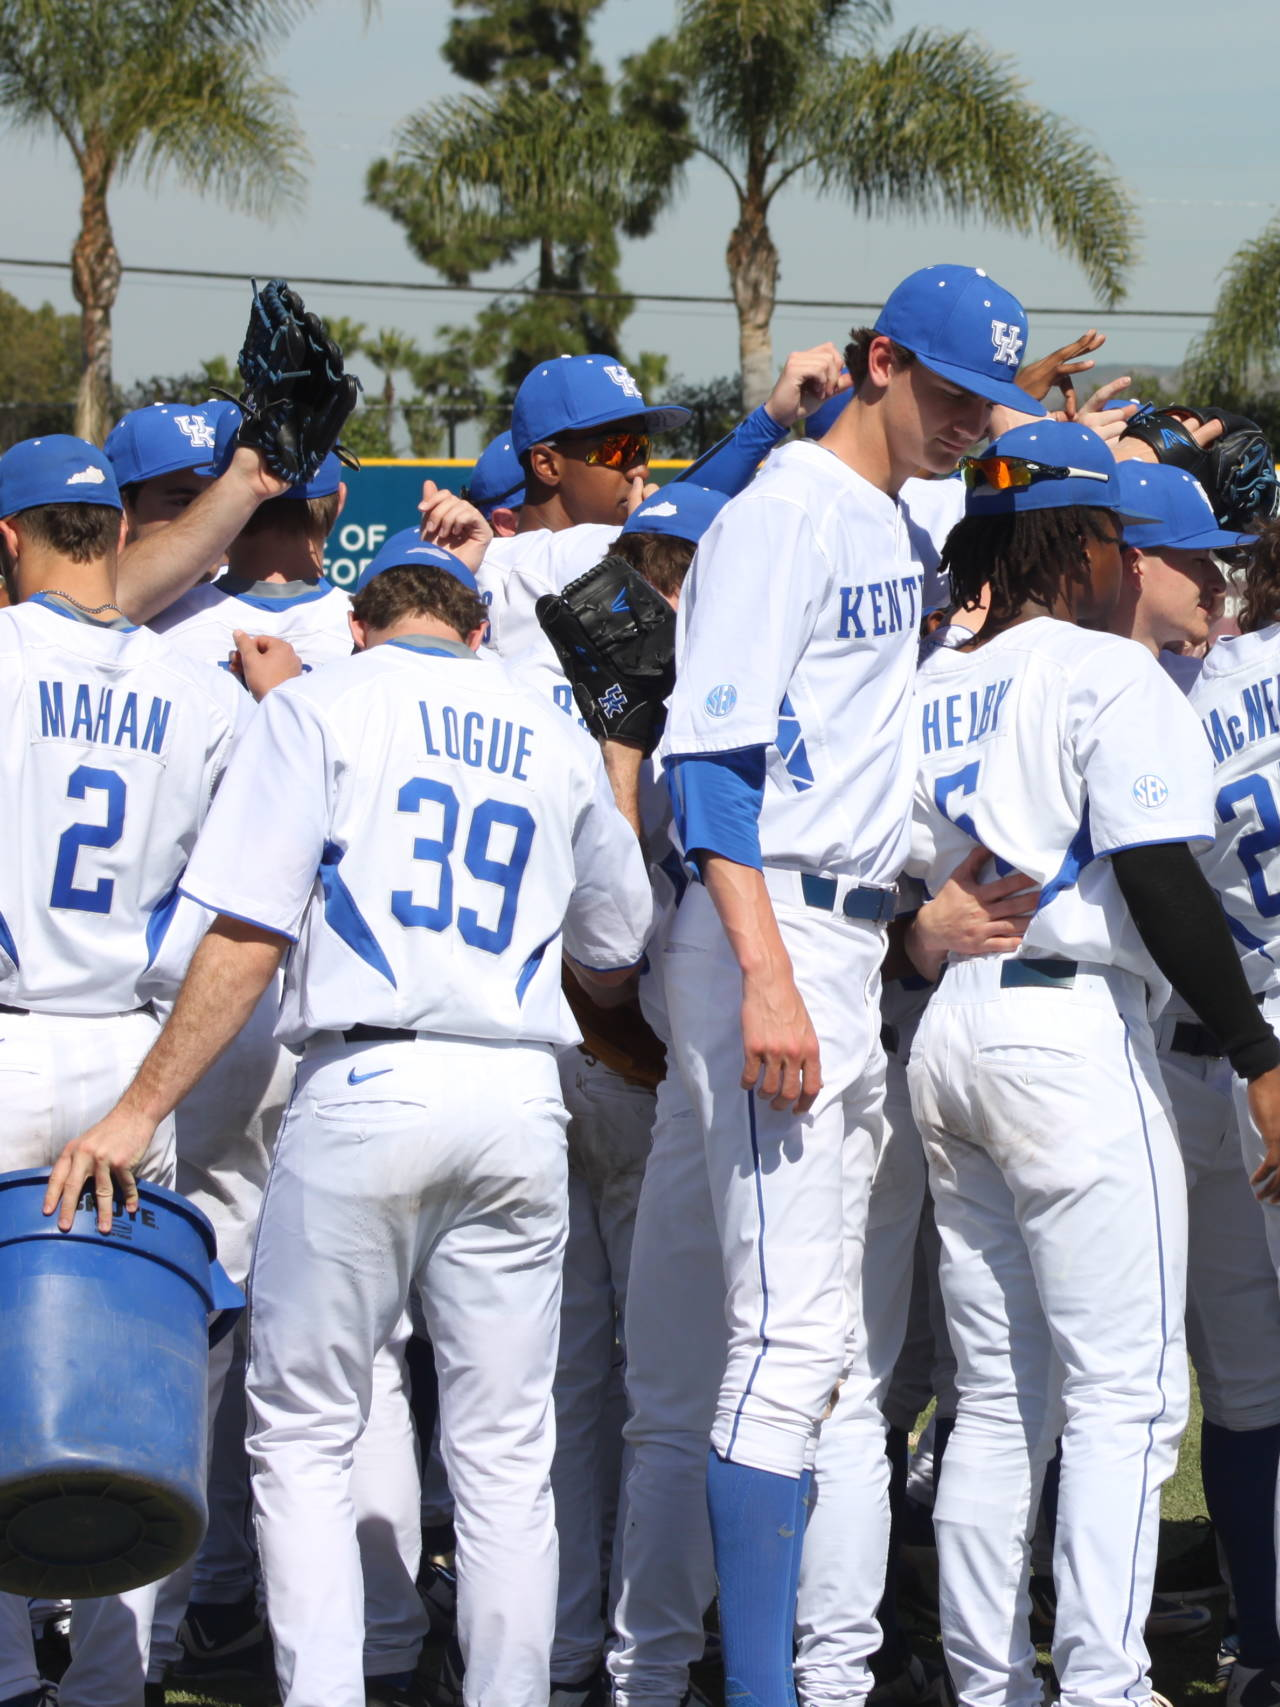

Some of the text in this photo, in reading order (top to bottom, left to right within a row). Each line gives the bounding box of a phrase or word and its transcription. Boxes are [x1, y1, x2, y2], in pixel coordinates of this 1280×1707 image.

[992, 320, 1023, 366] UK
[174, 415, 215, 448] UK
[339, 524, 387, 551] OF
[39, 680, 172, 754] MAHAN
[418, 701, 534, 781] LOGUE
[1133, 775, 1168, 807] SEC
[49, 765, 127, 915] 2
[391, 777, 536, 956] 39
